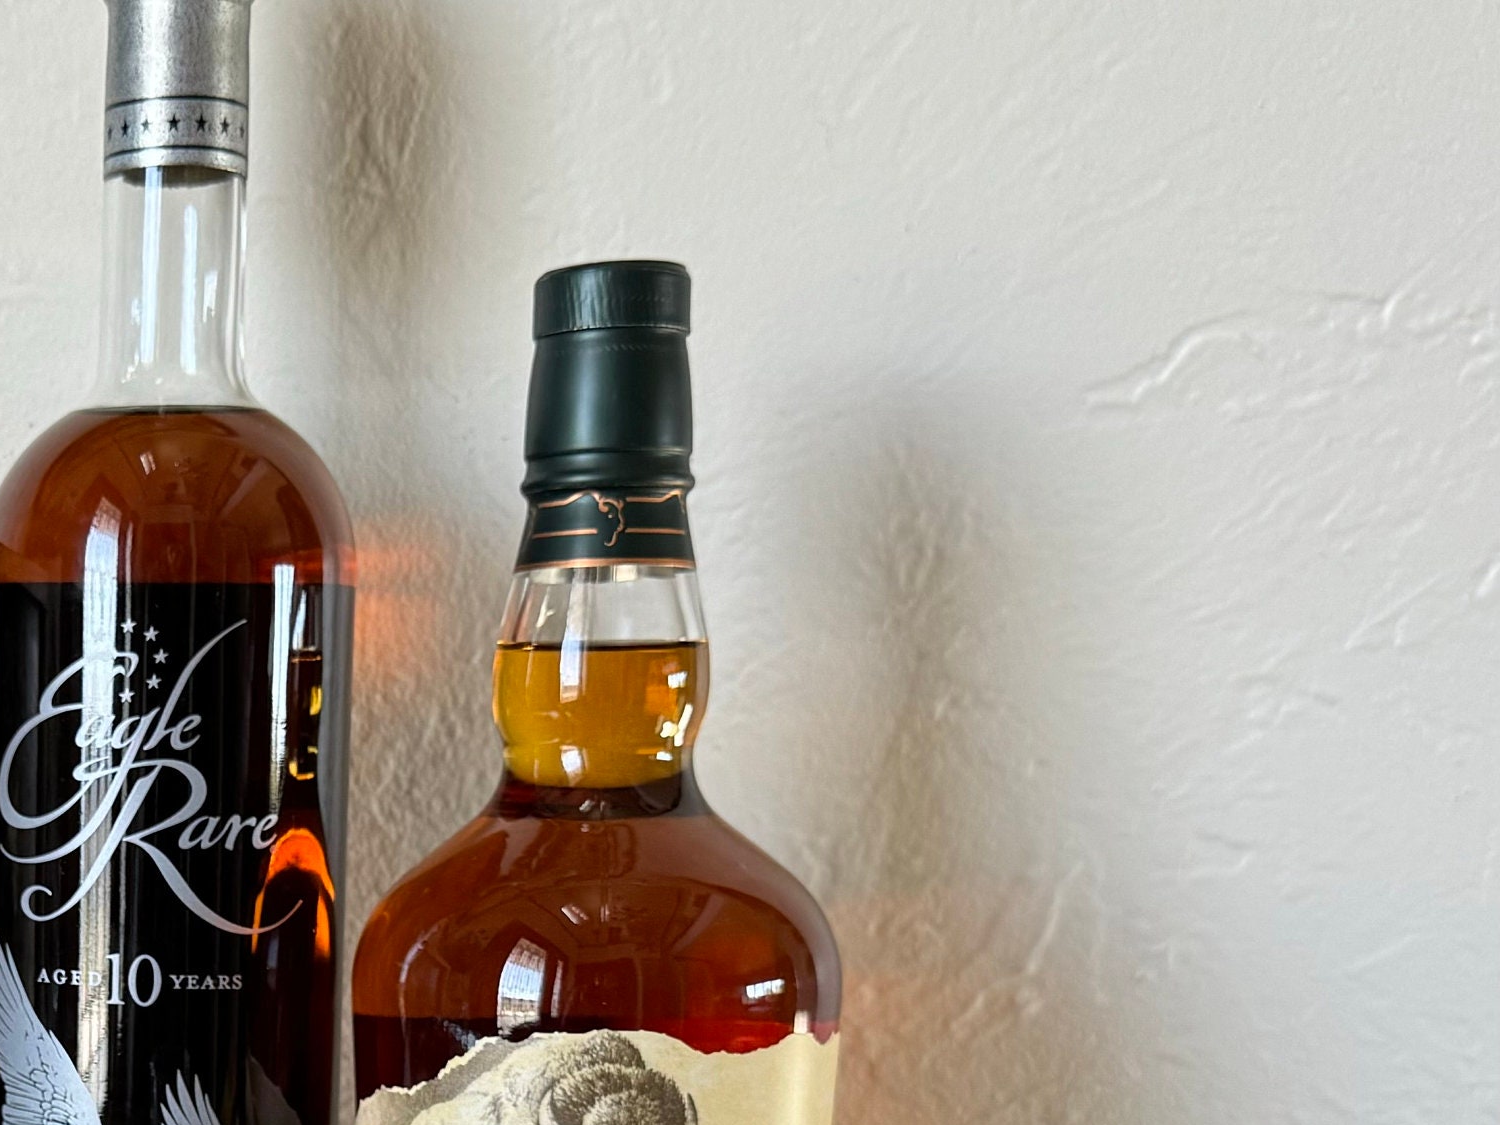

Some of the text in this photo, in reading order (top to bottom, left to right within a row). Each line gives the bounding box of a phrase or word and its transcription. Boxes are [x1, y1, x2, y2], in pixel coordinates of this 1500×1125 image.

[20, 757, 303, 936] Rare
[37, 953, 243, 1007] AGED 10 YEARS
